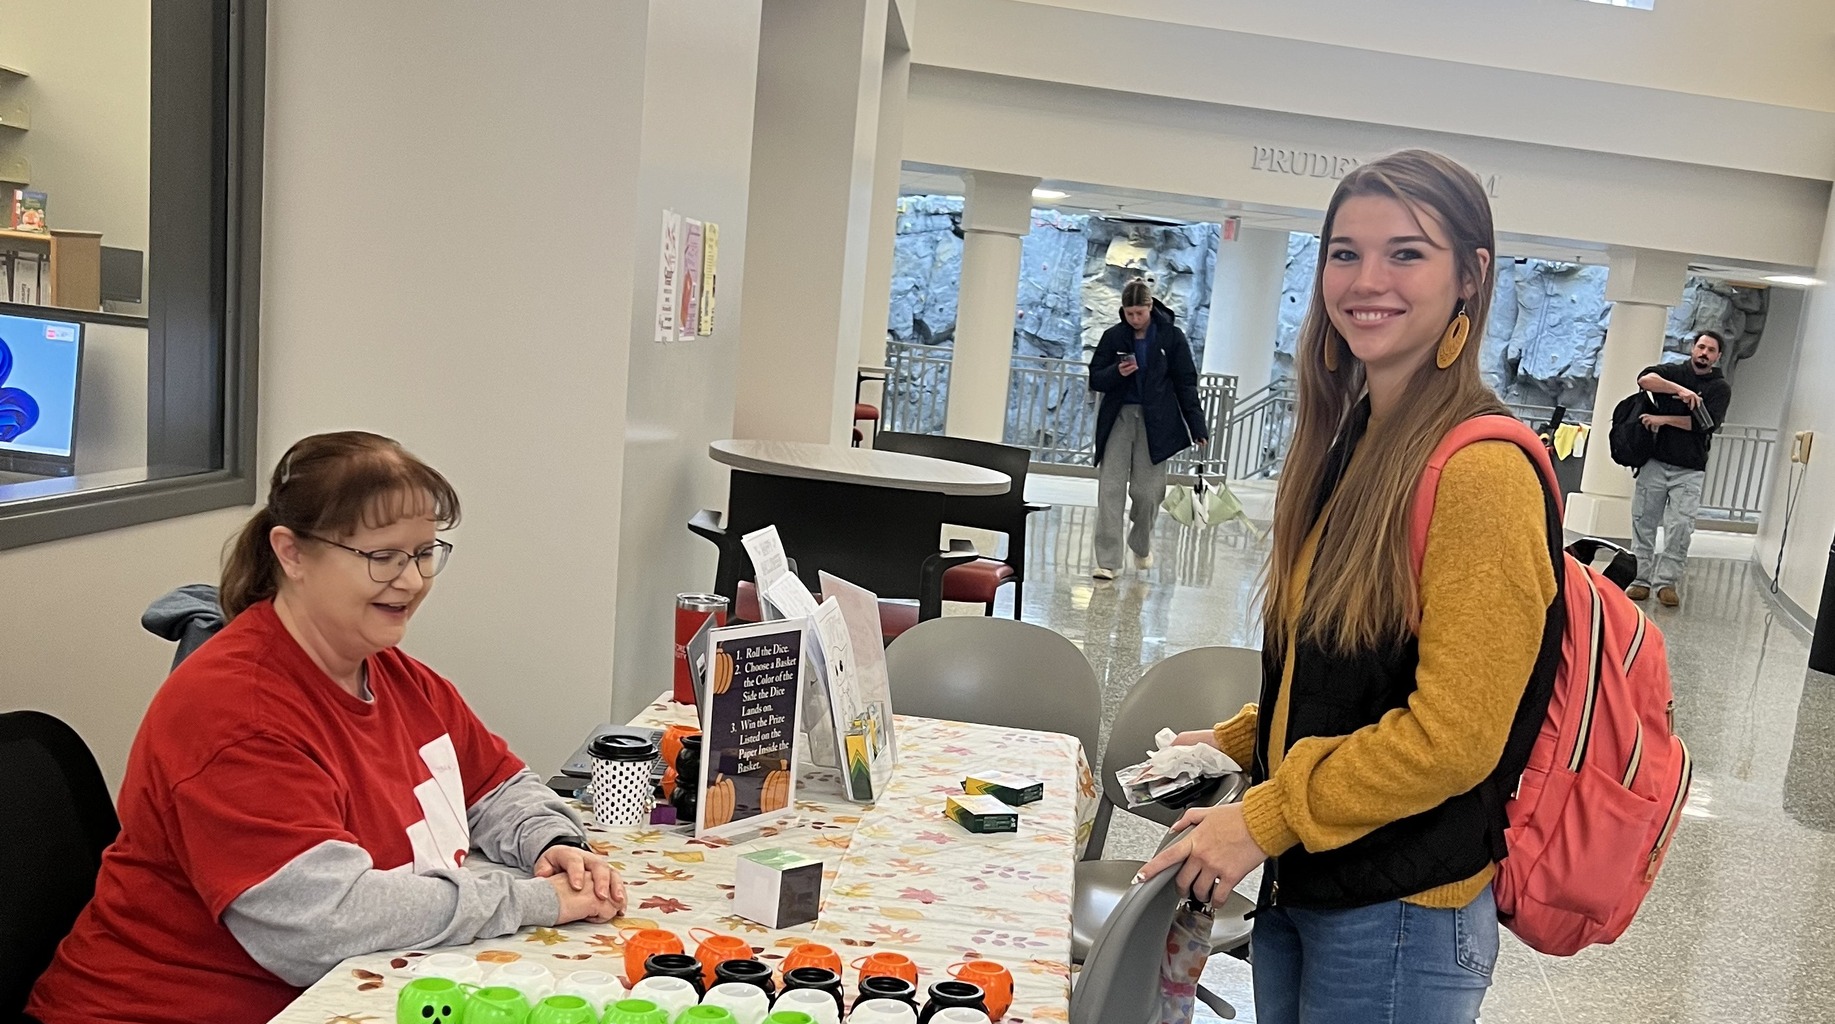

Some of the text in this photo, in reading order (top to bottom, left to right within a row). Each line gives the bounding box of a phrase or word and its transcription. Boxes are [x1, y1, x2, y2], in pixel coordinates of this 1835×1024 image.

[1251, 146, 1360, 181] PRUDE
[737, 644, 789, 660] 1. Roll the Dice.
[735, 665, 741, 675] 2.
[745, 662, 770, 673] Choose
[776, 657, 797, 668] Basket
[744, 672, 793, 688] the Color of the
[743, 686, 785, 702] Side the Dice
[742, 704, 773, 717] Lands on.
[730, 715, 785, 733] 3. Win the Prize
[740, 729, 781, 745] Listed on the
[738, 740, 789, 761] Paper Inside the
[738, 762, 761, 773] Basket.
